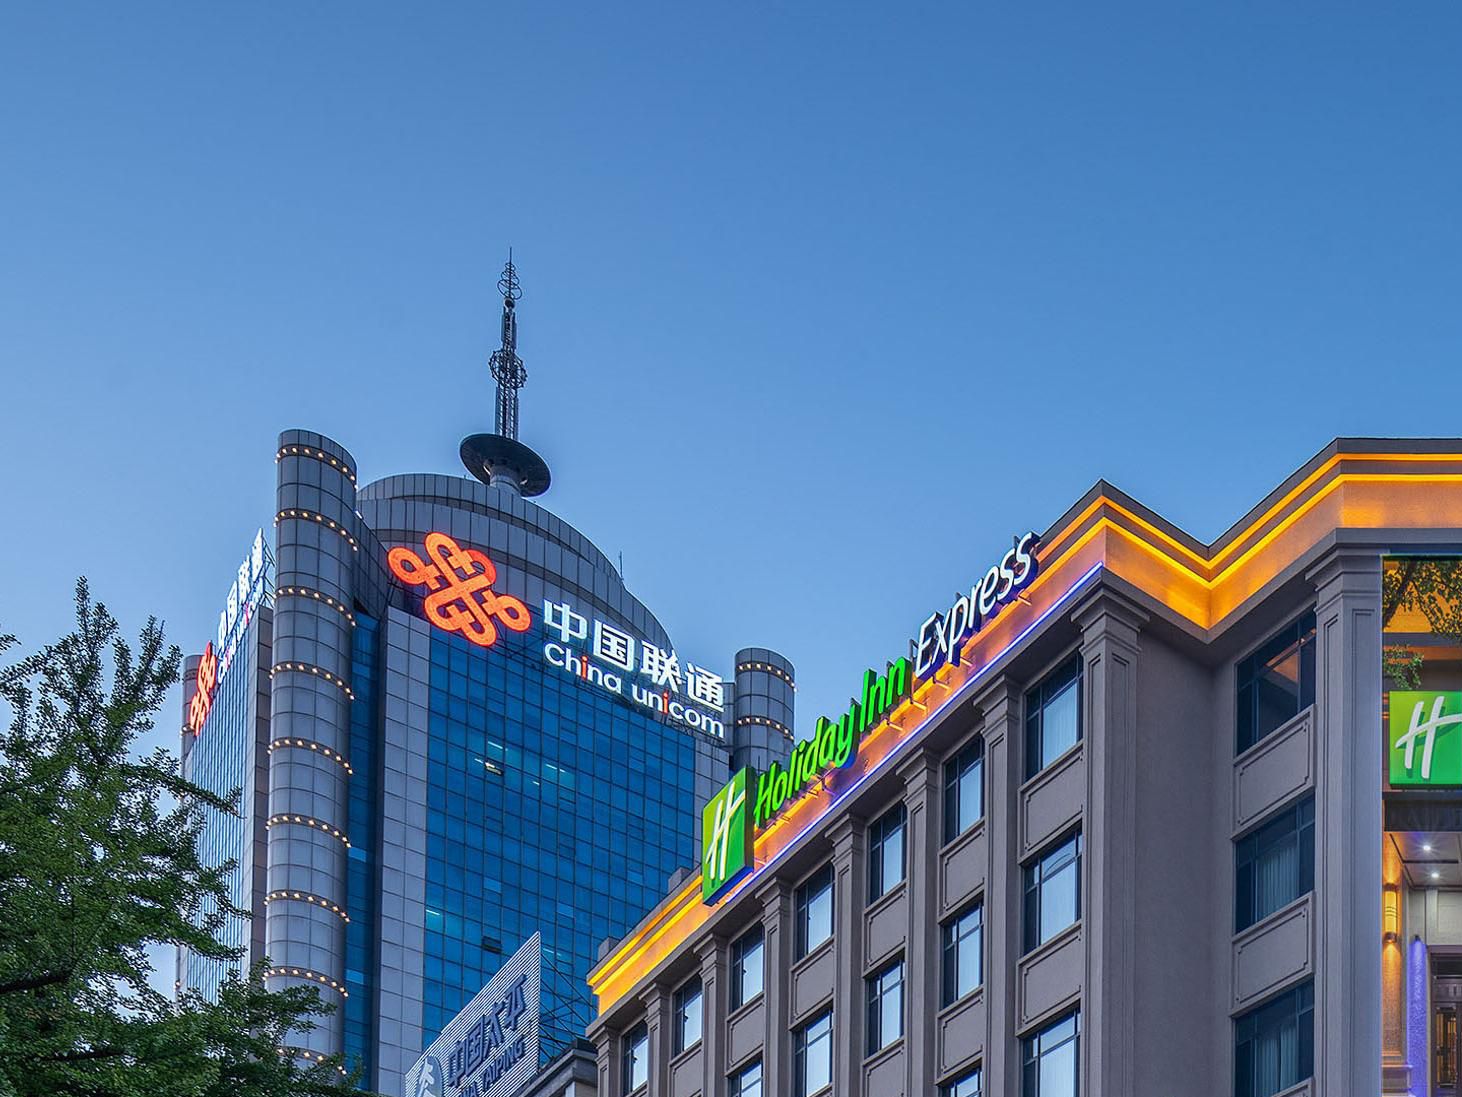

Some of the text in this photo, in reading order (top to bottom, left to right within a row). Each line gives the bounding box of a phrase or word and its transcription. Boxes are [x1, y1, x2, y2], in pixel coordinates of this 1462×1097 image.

[543, 599, 725, 713] 中国联通
[543, 642, 725, 739] China unicom
[754, 531, 1038, 828] Holiday Inn Express
[448, 973, 528, 1088] 中国太平
[479, 1036, 526, 1093] TAIPING
